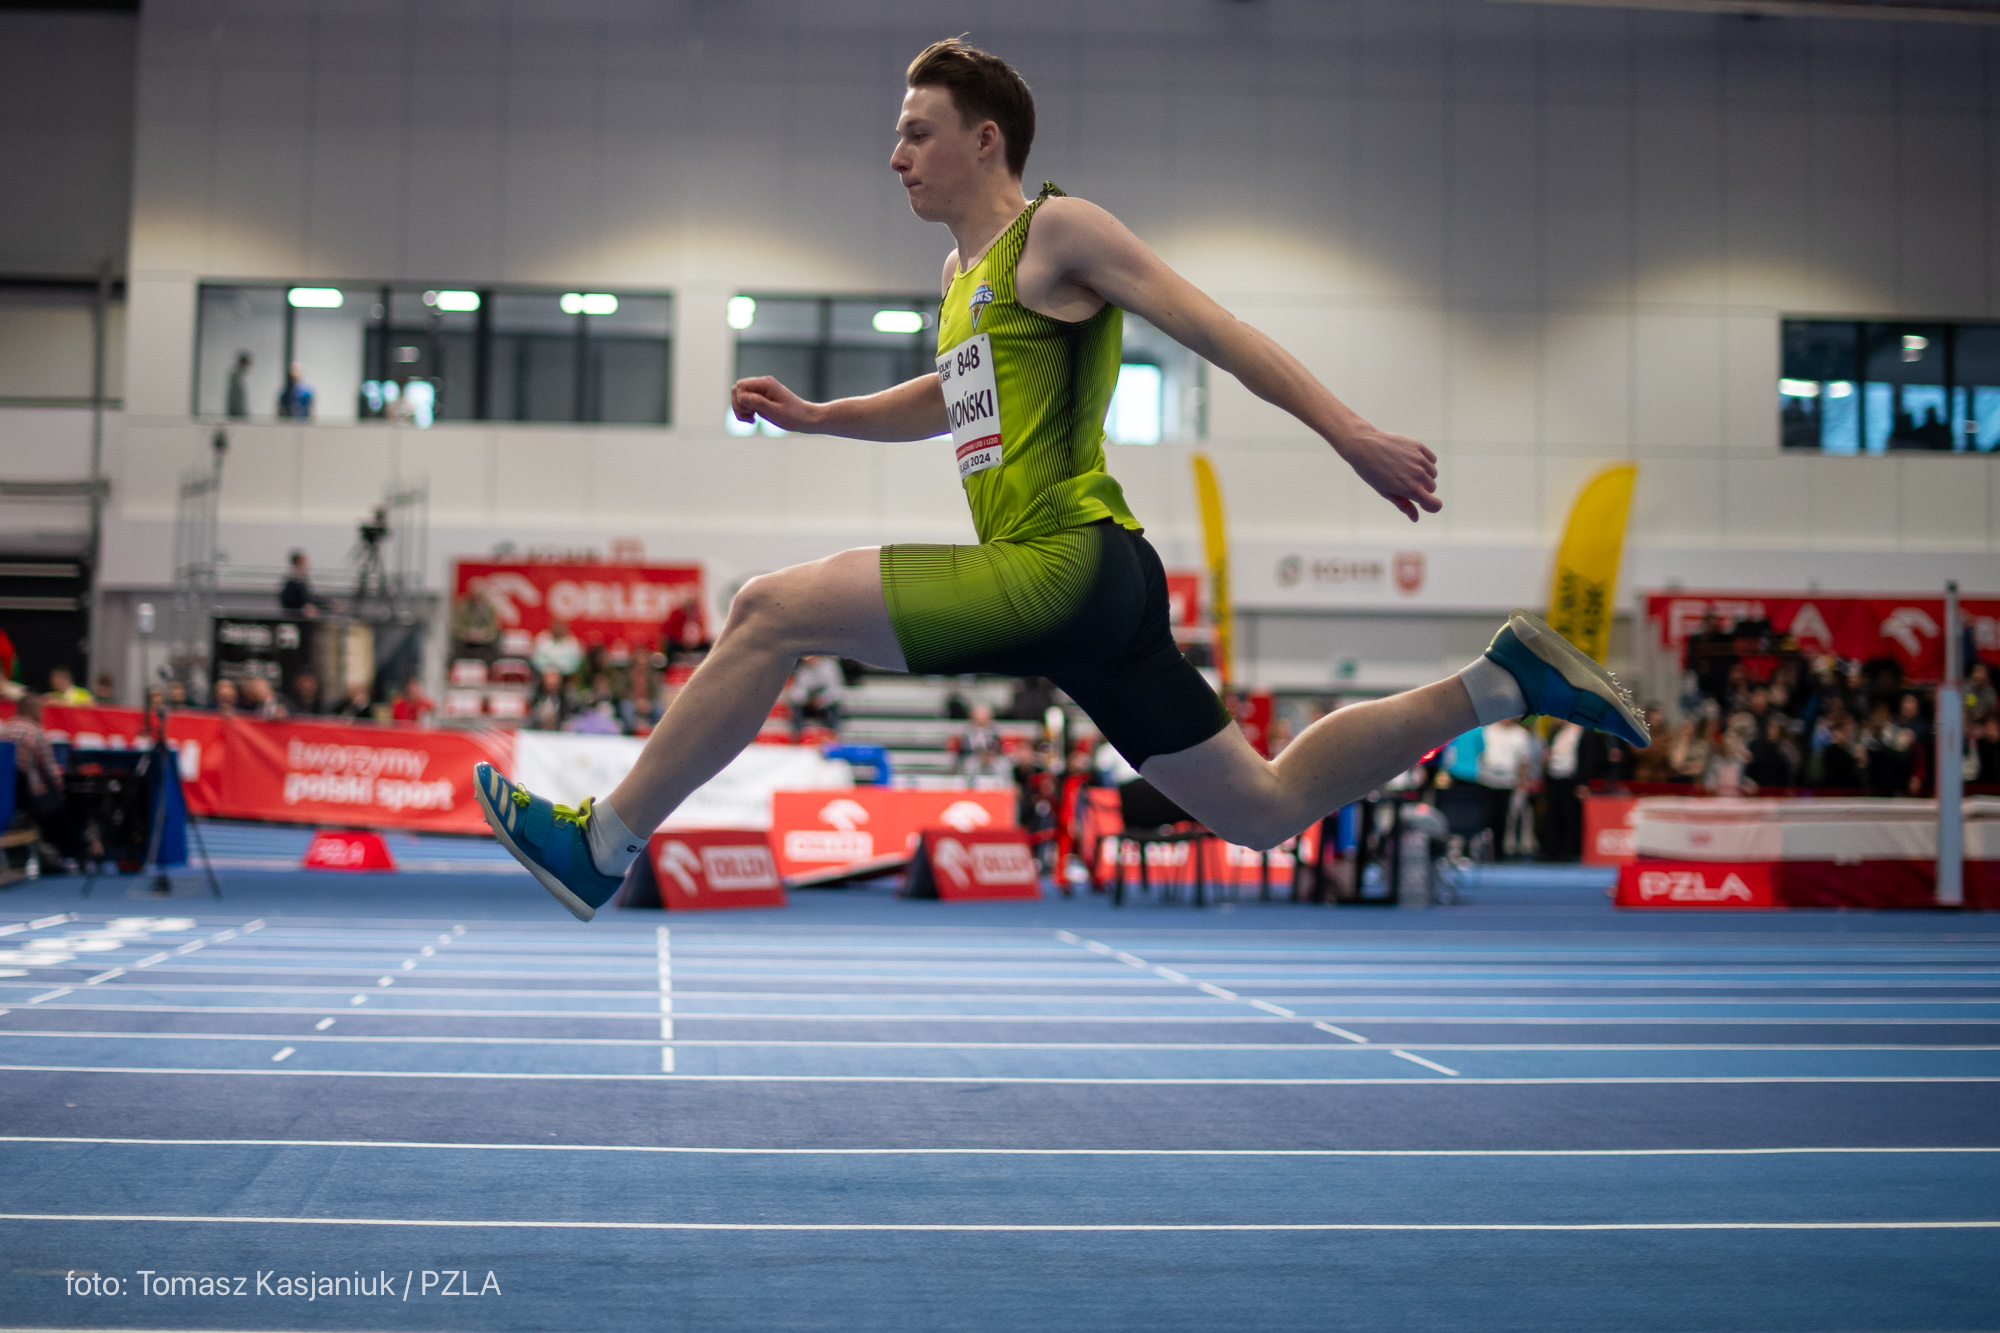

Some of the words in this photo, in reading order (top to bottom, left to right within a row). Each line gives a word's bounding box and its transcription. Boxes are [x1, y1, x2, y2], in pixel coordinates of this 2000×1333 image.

[957, 344, 980, 376] 848
[970, 453, 991, 467] 2024
[284, 772, 373, 805] polski
[375, 777, 454, 812] sport
[1638, 871, 1754, 901] PZLA
